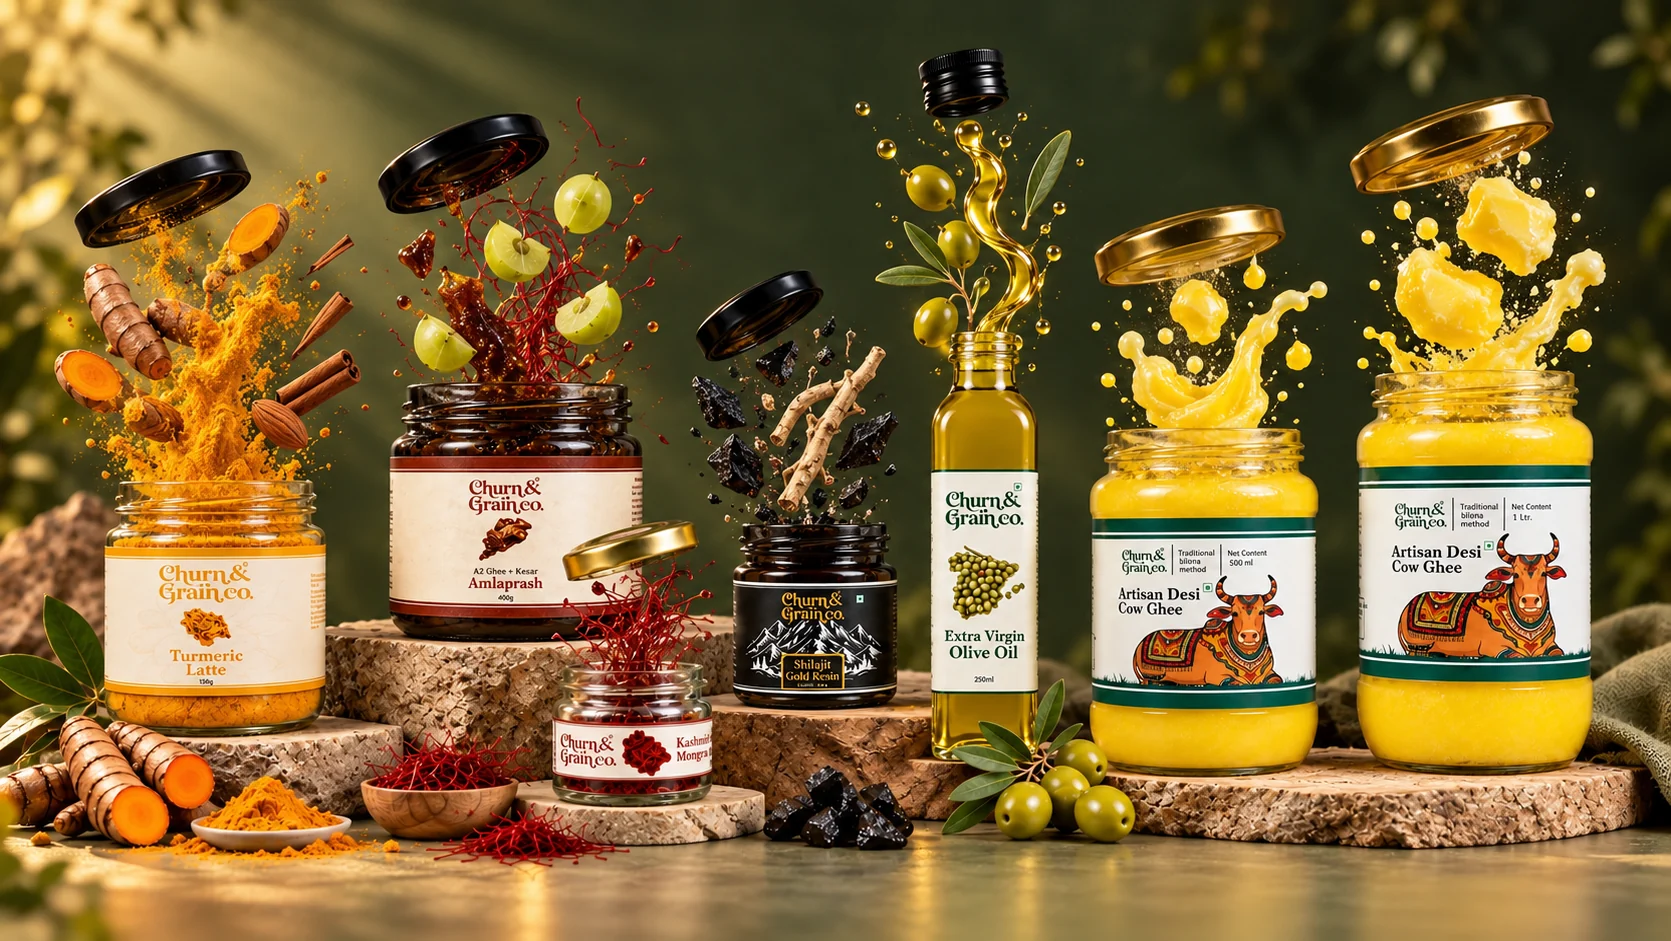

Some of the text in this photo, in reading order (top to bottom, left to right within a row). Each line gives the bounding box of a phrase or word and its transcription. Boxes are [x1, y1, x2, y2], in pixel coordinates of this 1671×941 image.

[1461, 503, 1498, 511] Traditional
[1461, 520, 1489, 528] method
[1178, 549, 1215, 557] Traditional
[1241, 549, 1267, 557] Content
[1392, 545, 1482, 559] Artisan Desi
[1229, 559, 1253, 567] 500 ml
[1392, 560, 1462, 574] Cow Ghee
[473, 568, 484, 576] A2
[486, 568, 506, 576] Ghee
[515, 568, 538, 576] Kesar
[468, 577, 543, 593] Amlaprash
[498, 595, 514, 603] 400g
[1118, 587, 1200, 600] Artisan Desi
[1118, 602, 1183, 615] Cow Ghee
[944, 630, 1025, 645] Extra Virgin
[169, 649, 243, 662] Turmeric
[949, 645, 1018, 659] Olive Oil
[186, 664, 226, 676] Latte
[793, 659, 831, 672] Shilajit
[785, 672, 840, 682] Gold Resin
[676, 750, 708, 762] Mongra
